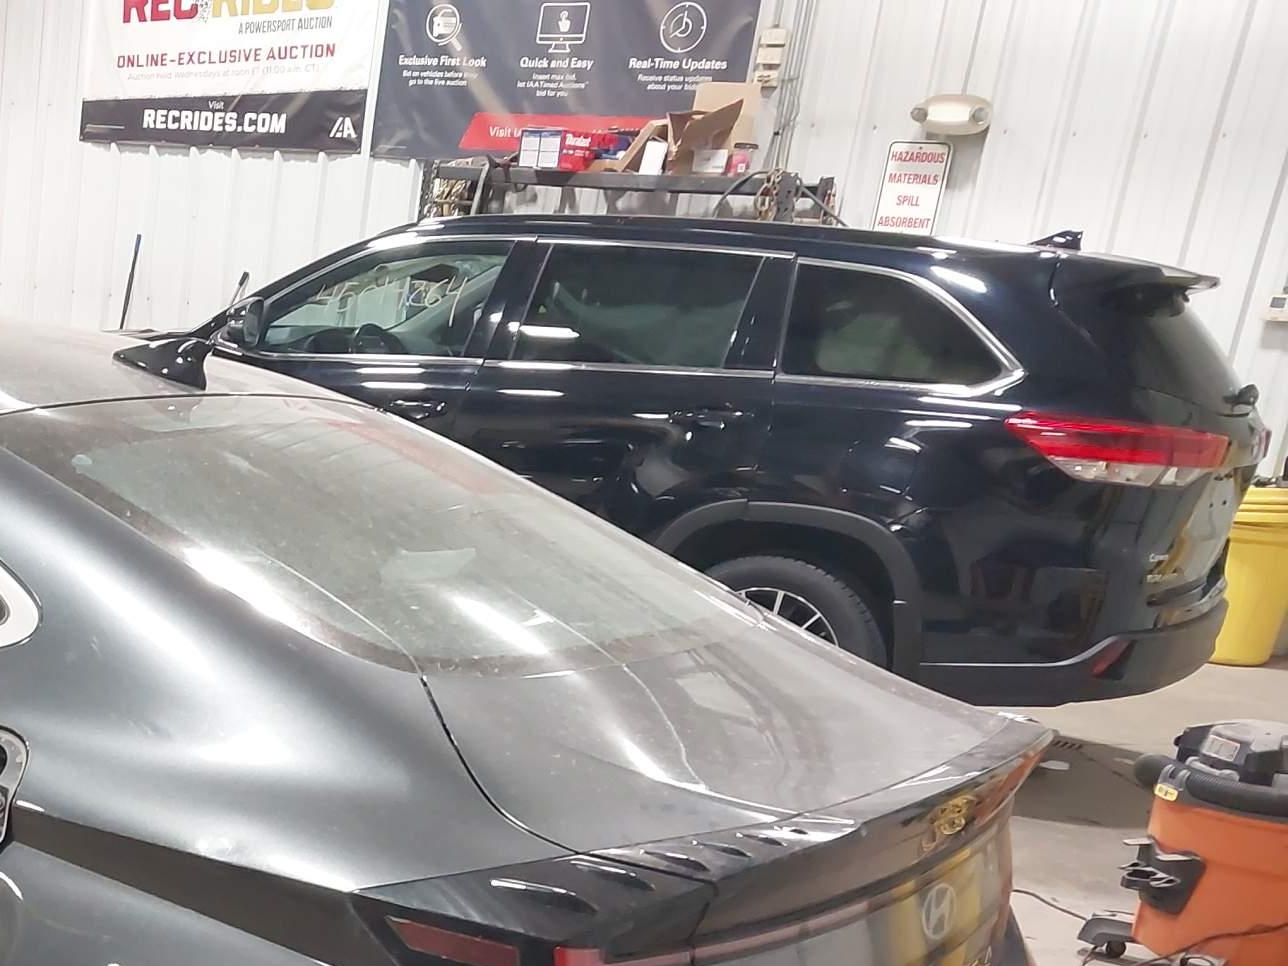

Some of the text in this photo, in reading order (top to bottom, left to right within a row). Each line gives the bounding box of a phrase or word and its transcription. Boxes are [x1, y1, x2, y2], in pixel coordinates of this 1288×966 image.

[245, 18, 296, 34] POWERSPORT
[297, 15, 333, 31] AUCTION
[117, 43, 337, 69] ONLINE-EXCLUSIVE AUCTION
[398, 54, 487, 68] Exclusive First Look
[520, 56, 594, 71] Quick and Easy
[628, 57, 728, 71] Real-Time Updates
[208, 100, 224, 110] Visit
[142, 109, 287, 135] RECRIDES.COM
[489, 126, 512, 138] Visit
[890, 151, 946, 164] HAZARDOUS
[888, 172, 940, 186] MATERIALS
[896, 194, 921, 207] SPILL
[877, 215, 931, 229] ABSORBENT
